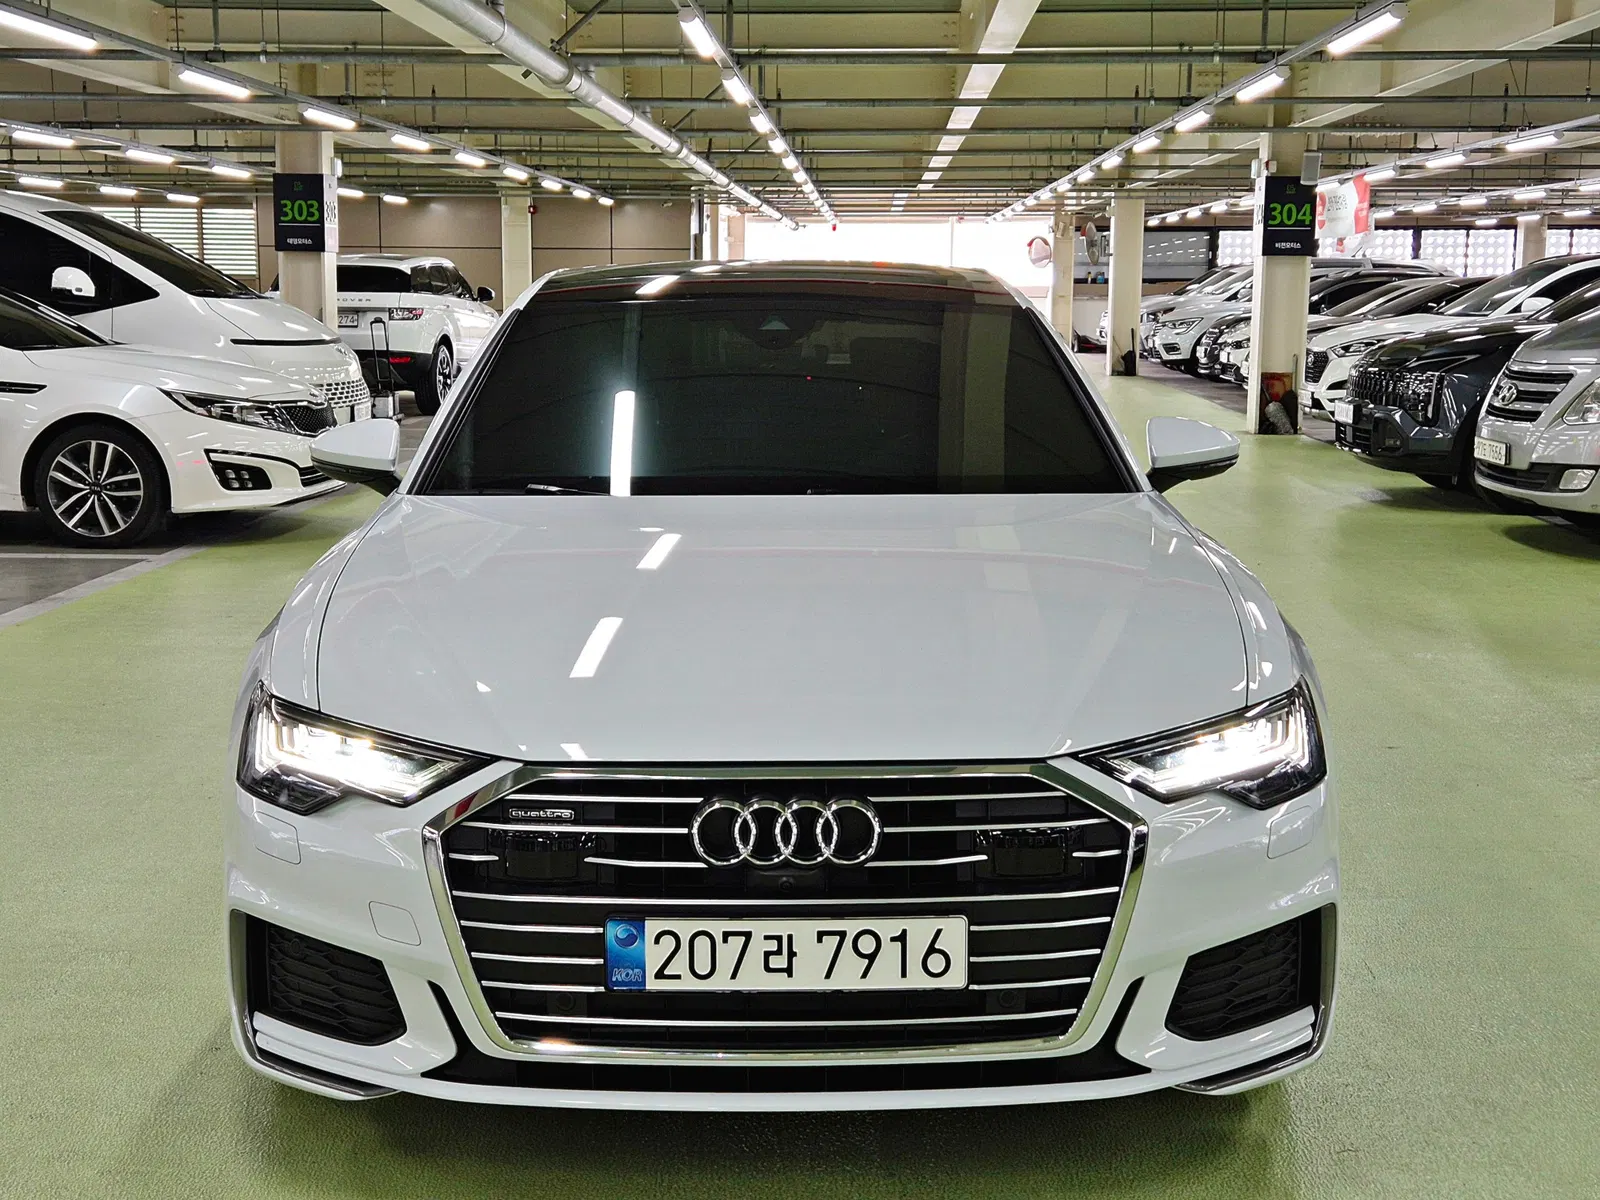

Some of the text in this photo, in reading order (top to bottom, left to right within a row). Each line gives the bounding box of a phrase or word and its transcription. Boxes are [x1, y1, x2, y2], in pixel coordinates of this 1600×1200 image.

[280, 199, 320, 221] 303
[1268, 202, 1313, 225] 304
[512, 810, 571, 819] quattro
[653, 928, 952, 980] 207라 7916
[611, 967, 643, 982] KOR
